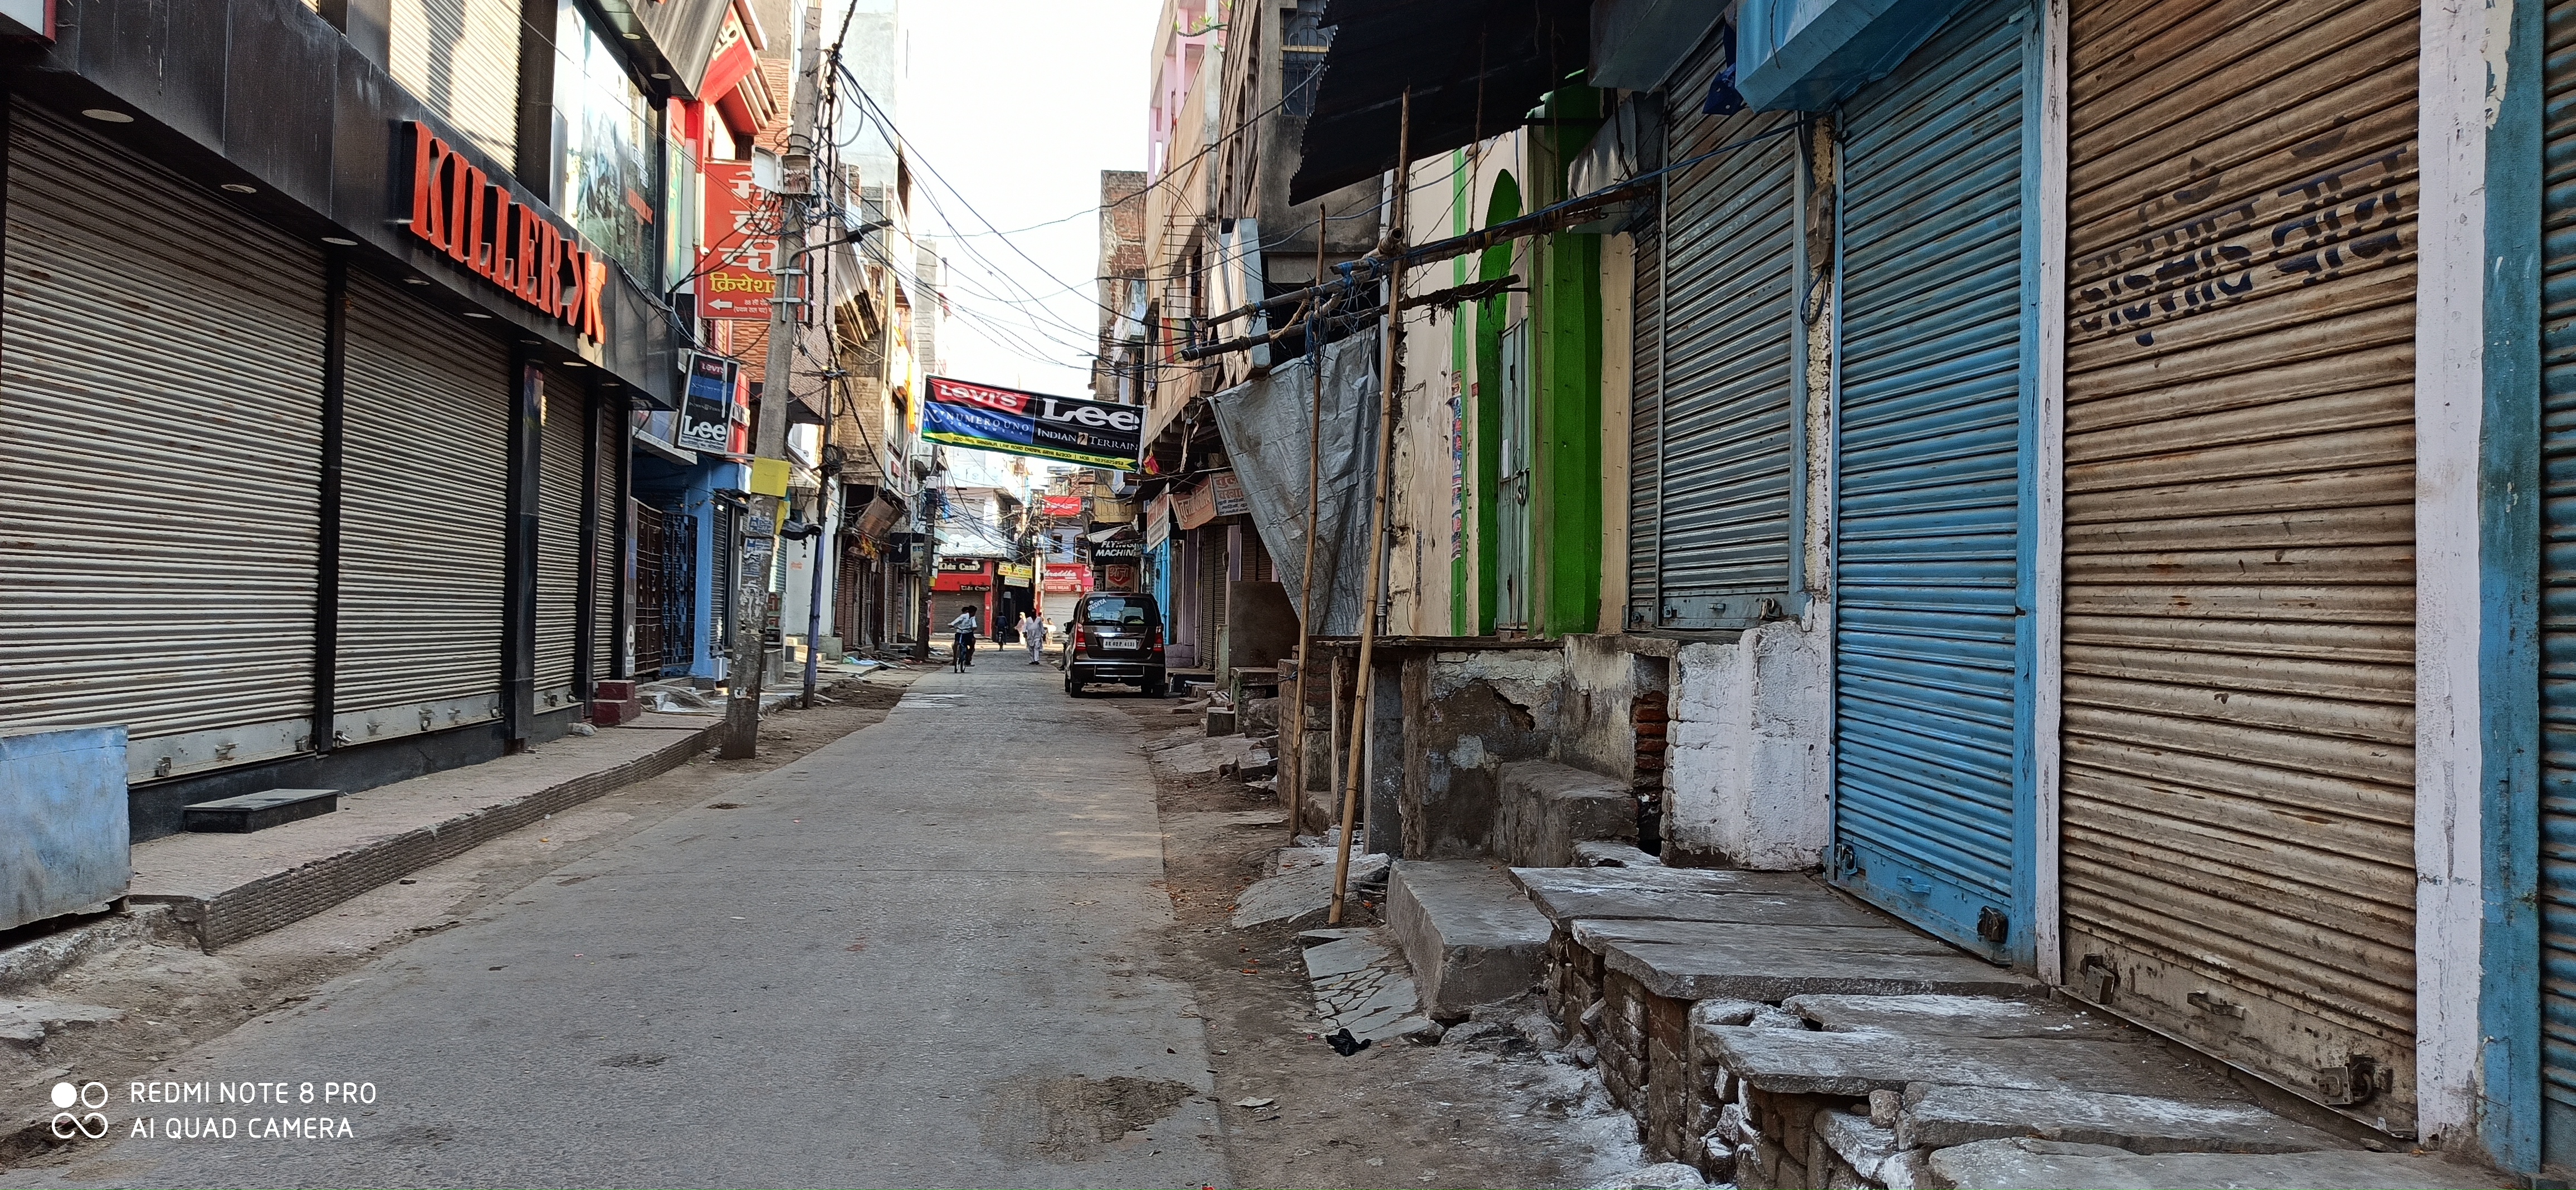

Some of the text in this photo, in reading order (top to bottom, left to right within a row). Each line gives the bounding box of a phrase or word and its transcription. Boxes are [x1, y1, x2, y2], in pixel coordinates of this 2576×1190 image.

[409, 120, 562, 318] KILLER
[947, 411, 1030, 432] NUMERO UNO
[1041, 398, 1140, 431] Lee
[684, 415, 726, 441] Lee
[1037, 427, 1138, 451] INDIAN TERRAIN
